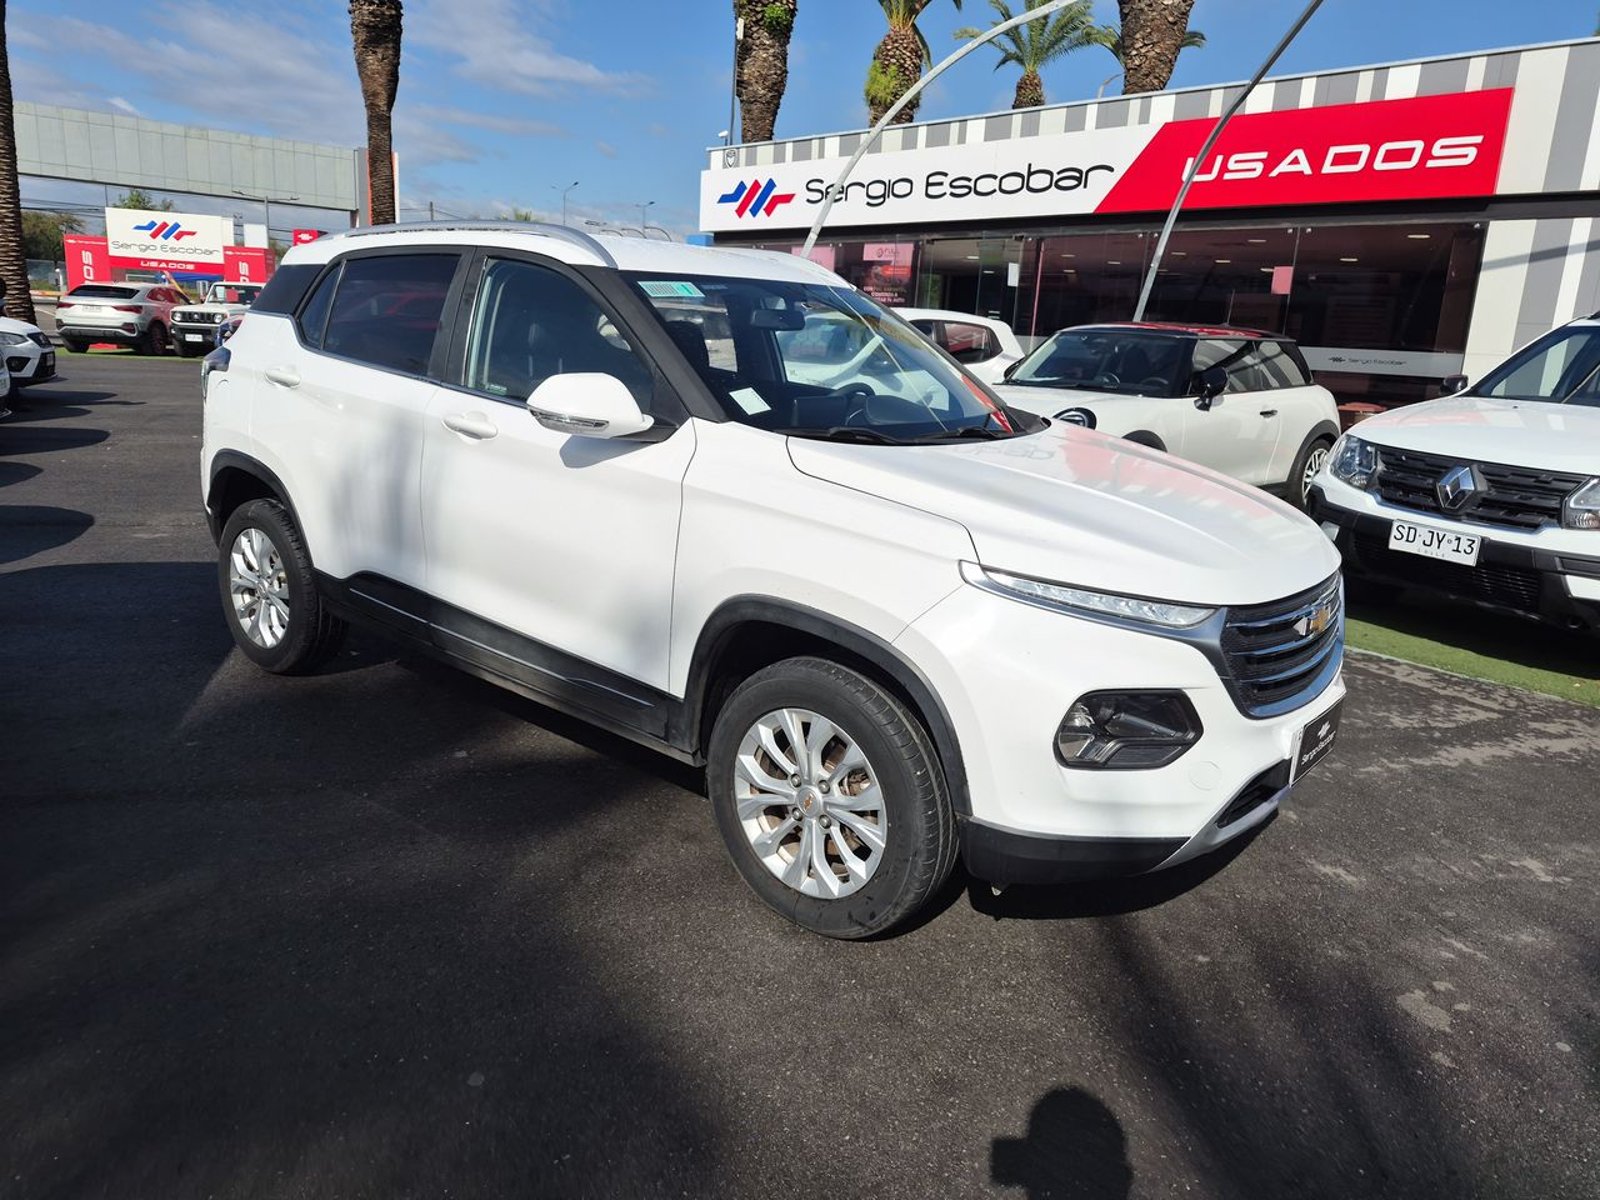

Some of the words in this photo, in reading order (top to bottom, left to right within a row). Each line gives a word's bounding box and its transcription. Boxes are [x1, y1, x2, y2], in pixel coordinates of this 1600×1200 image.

[1179, 134, 1485, 183] USADOS
[805, 177, 914, 208] Sergio
[924, 163, 1116, 200] Escobar
[160, 244, 220, 256] Escobar
[140, 260, 195, 270] USADOS
